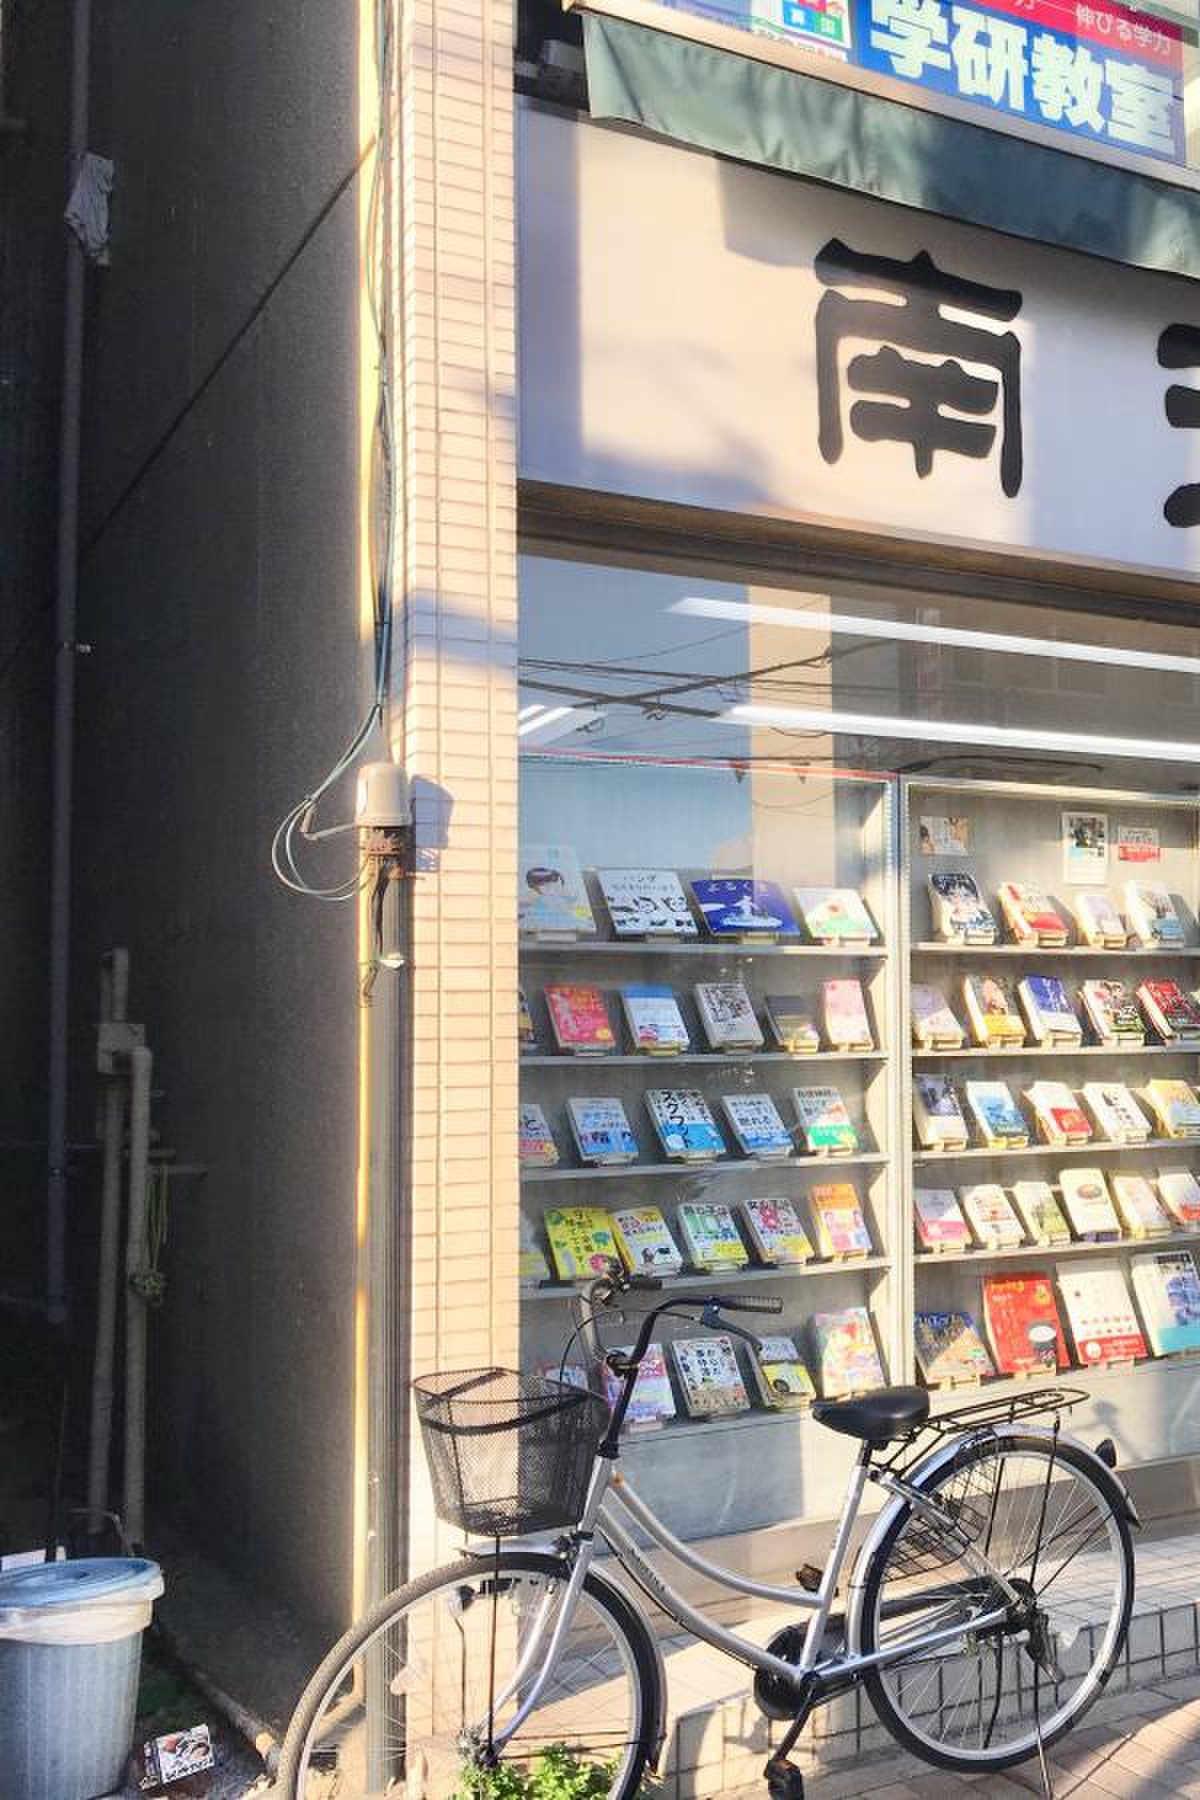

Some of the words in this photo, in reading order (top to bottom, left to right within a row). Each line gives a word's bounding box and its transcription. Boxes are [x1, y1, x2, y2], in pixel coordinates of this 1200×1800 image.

[868, 0, 1178, 156] 学研教室
[1075, 3, 1171, 54] 伸びる学力
